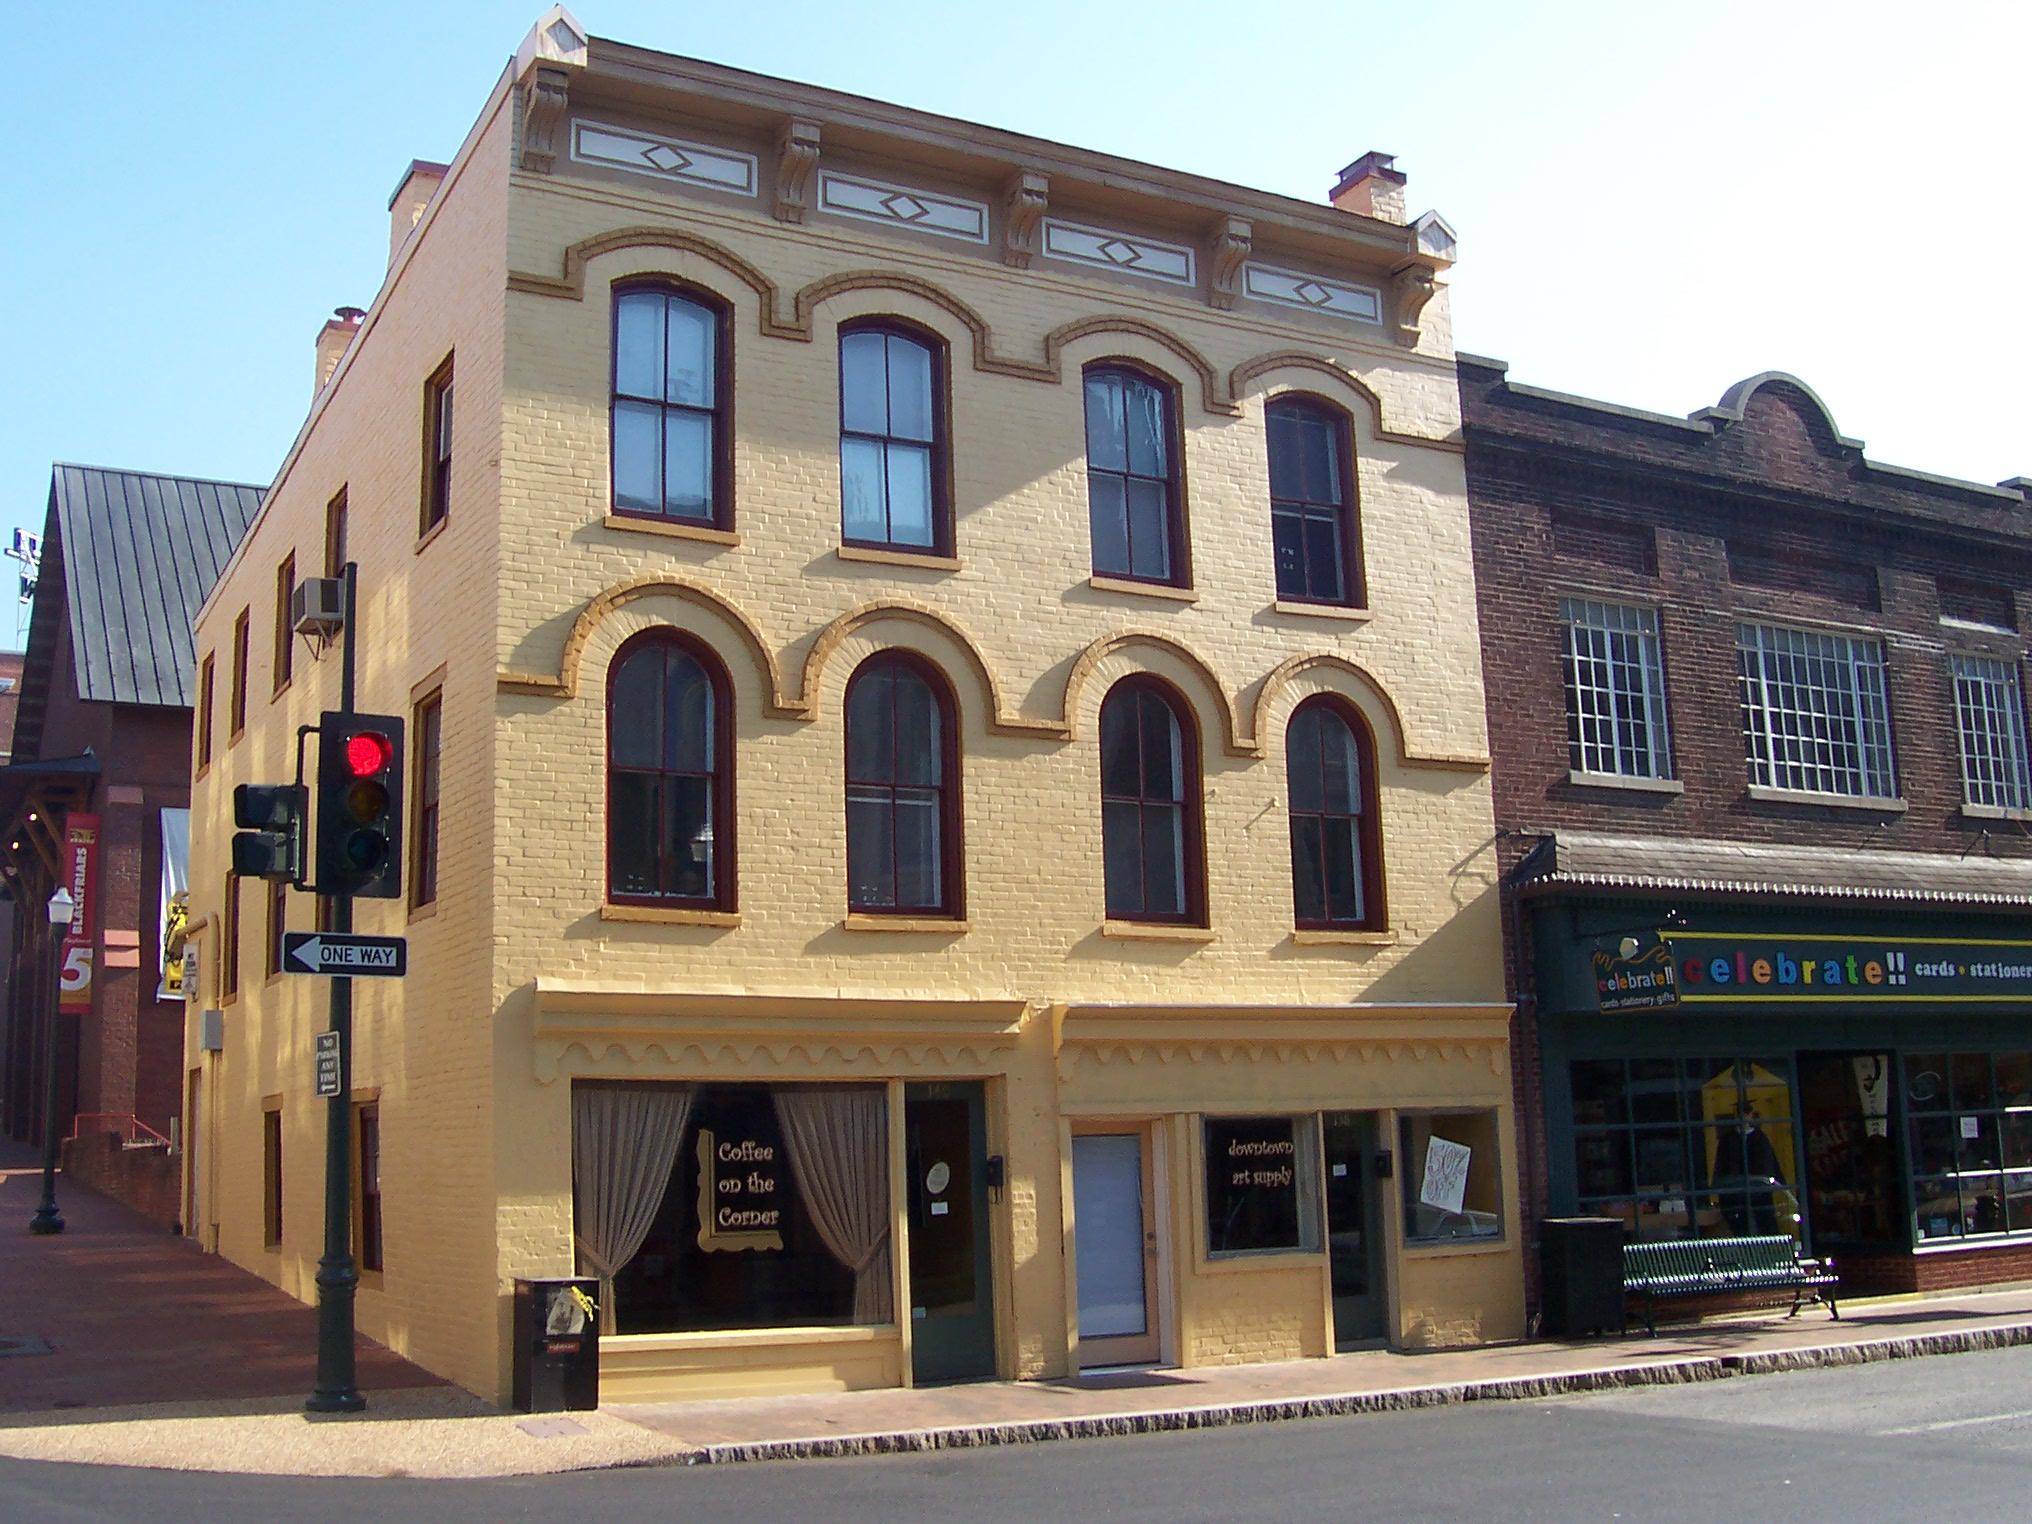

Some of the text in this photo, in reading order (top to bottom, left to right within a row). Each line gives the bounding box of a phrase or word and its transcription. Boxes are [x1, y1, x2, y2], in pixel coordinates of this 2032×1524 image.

[72, 847, 87, 934] BLACKFRIARS
[320, 946, 393, 964] ONE WAY
[1683, 951, 1907, 985] celebrate!!
[1915, 960, 1956, 977] cards
[719, 1140, 774, 1161] Coffee
[1228, 1139, 1294, 1155] downtown
[719, 1171, 775, 1193] on the
[1232, 1165, 1293, 1187] art supply
[719, 1207, 780, 1226] Corner
